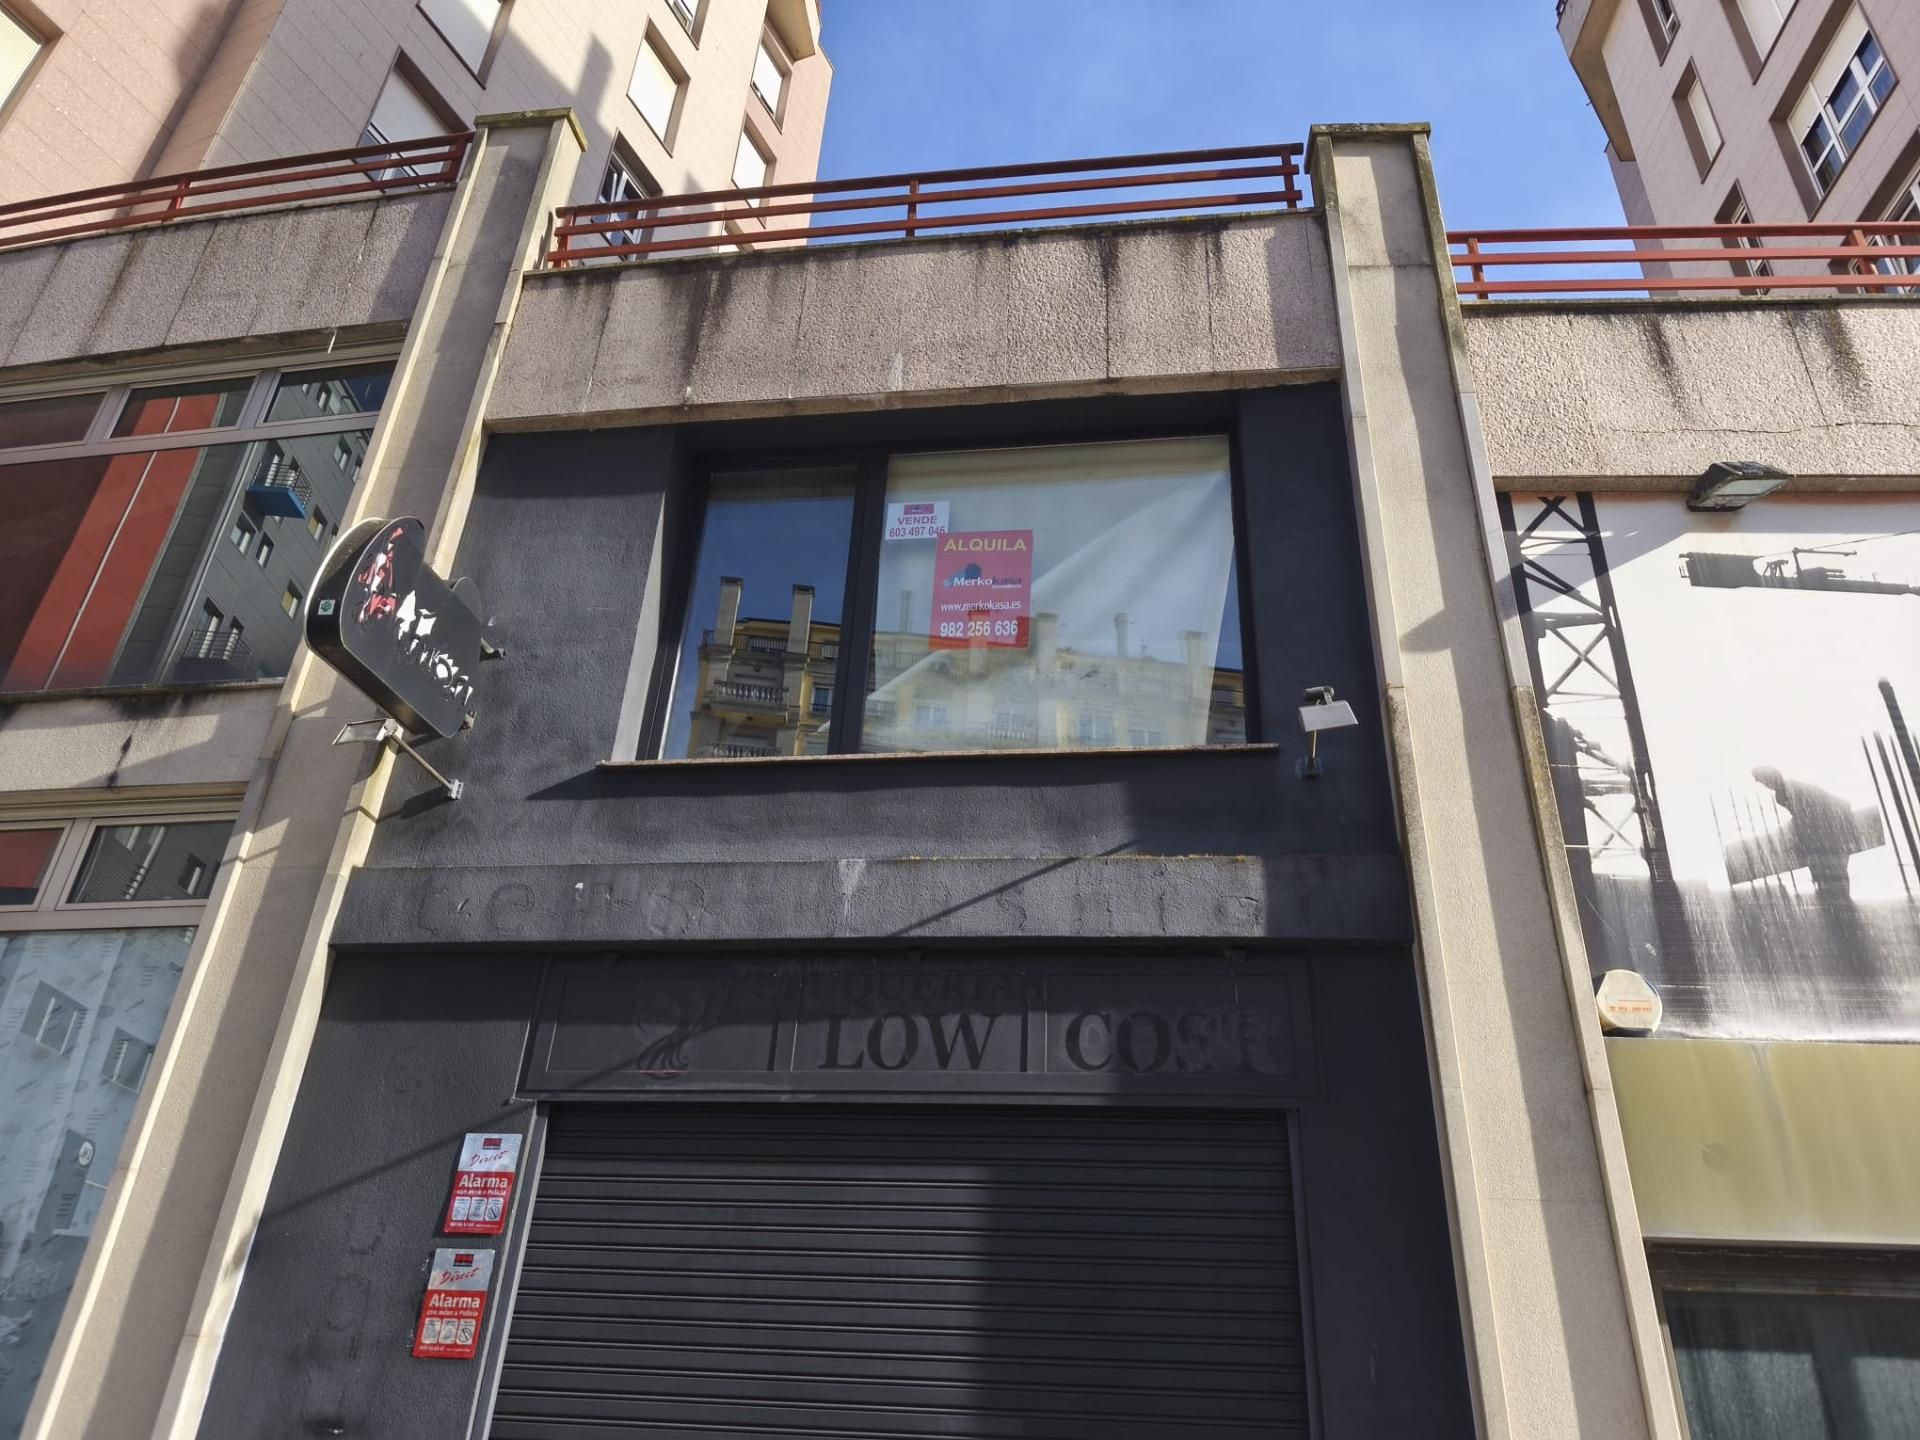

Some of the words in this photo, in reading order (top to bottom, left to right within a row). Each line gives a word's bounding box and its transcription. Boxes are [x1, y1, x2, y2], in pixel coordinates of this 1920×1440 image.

[897, 515, 938, 526] VENDE
[889, 528, 906, 538] 603
[909, 526, 926, 537] 497
[943, 538, 1027, 551] ALQUILA
[940, 600, 1022, 613] www.merkokasa.es
[940, 622, 964, 637] 982
[967, 621, 991, 637] 256
[994, 620, 1019, 636] 636
[817, 1011, 1003, 1071] LOW
[459, 1173, 508, 1188] Alarma
[429, 1293, 480, 1308] Alarma
